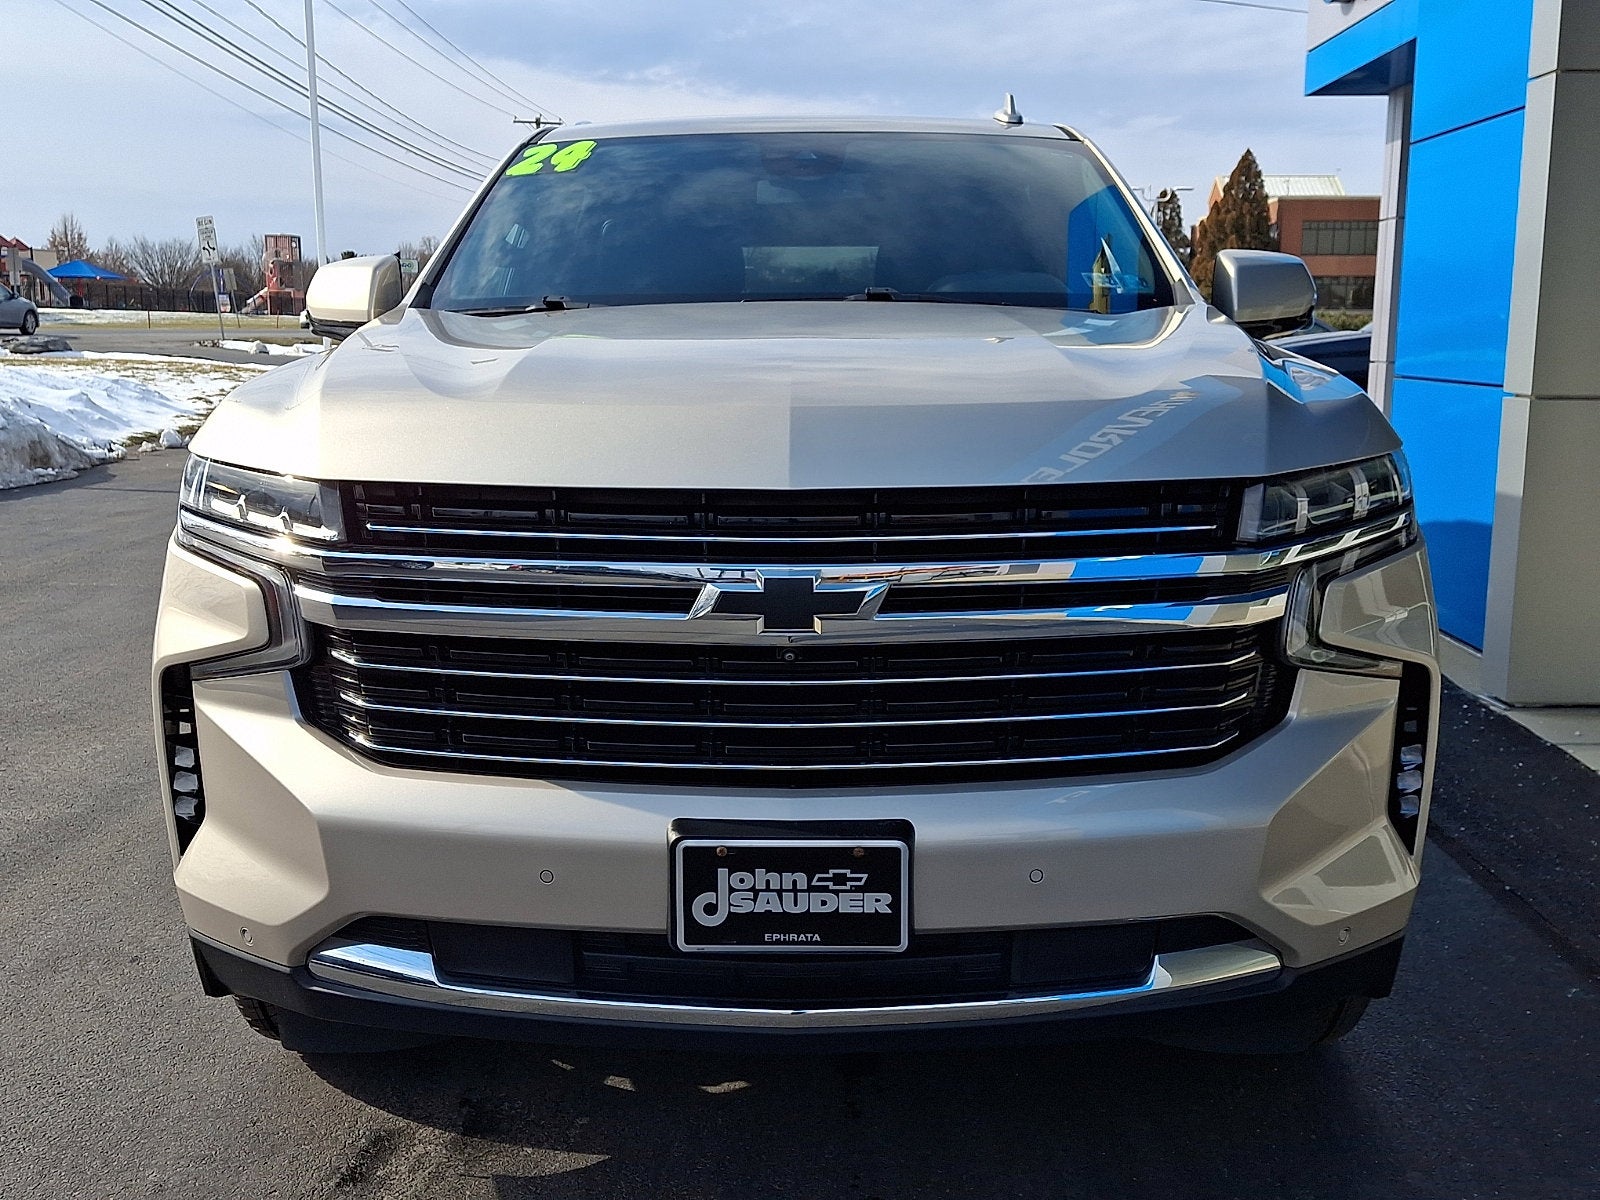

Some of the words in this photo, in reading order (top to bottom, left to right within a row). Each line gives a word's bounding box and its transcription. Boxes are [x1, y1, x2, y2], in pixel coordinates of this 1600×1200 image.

[504, 139, 598, 177] 24
[692, 868, 808, 927] John
[730, 892, 893, 914] SAUDER
[764, 933, 821, 942] EPHRATA
